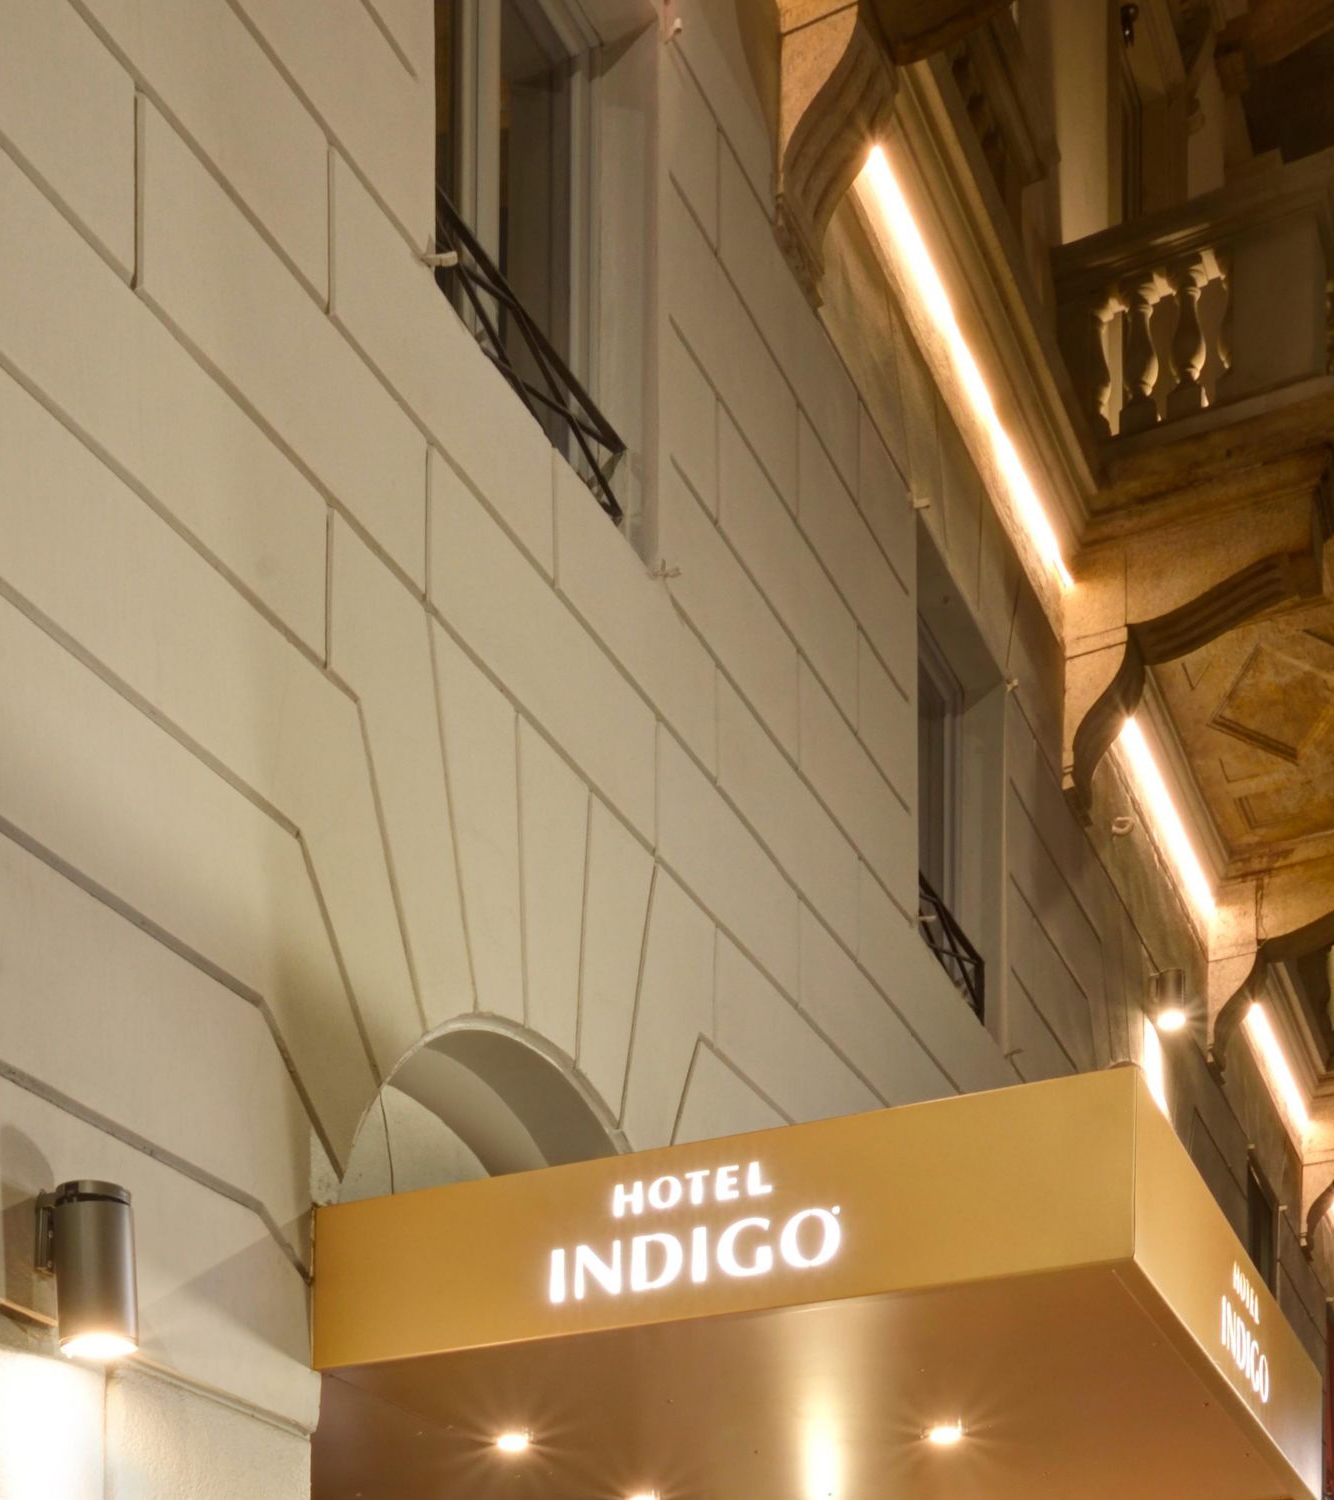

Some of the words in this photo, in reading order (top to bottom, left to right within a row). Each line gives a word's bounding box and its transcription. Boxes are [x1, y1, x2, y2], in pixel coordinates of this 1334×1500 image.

[612, 1160, 773, 1218] HOTEL
[548, 1206, 842, 1304] INDIGO
[1232, 1260, 1260, 1325] HOTEL
[1221, 1294, 1270, 1404] INDIGO
